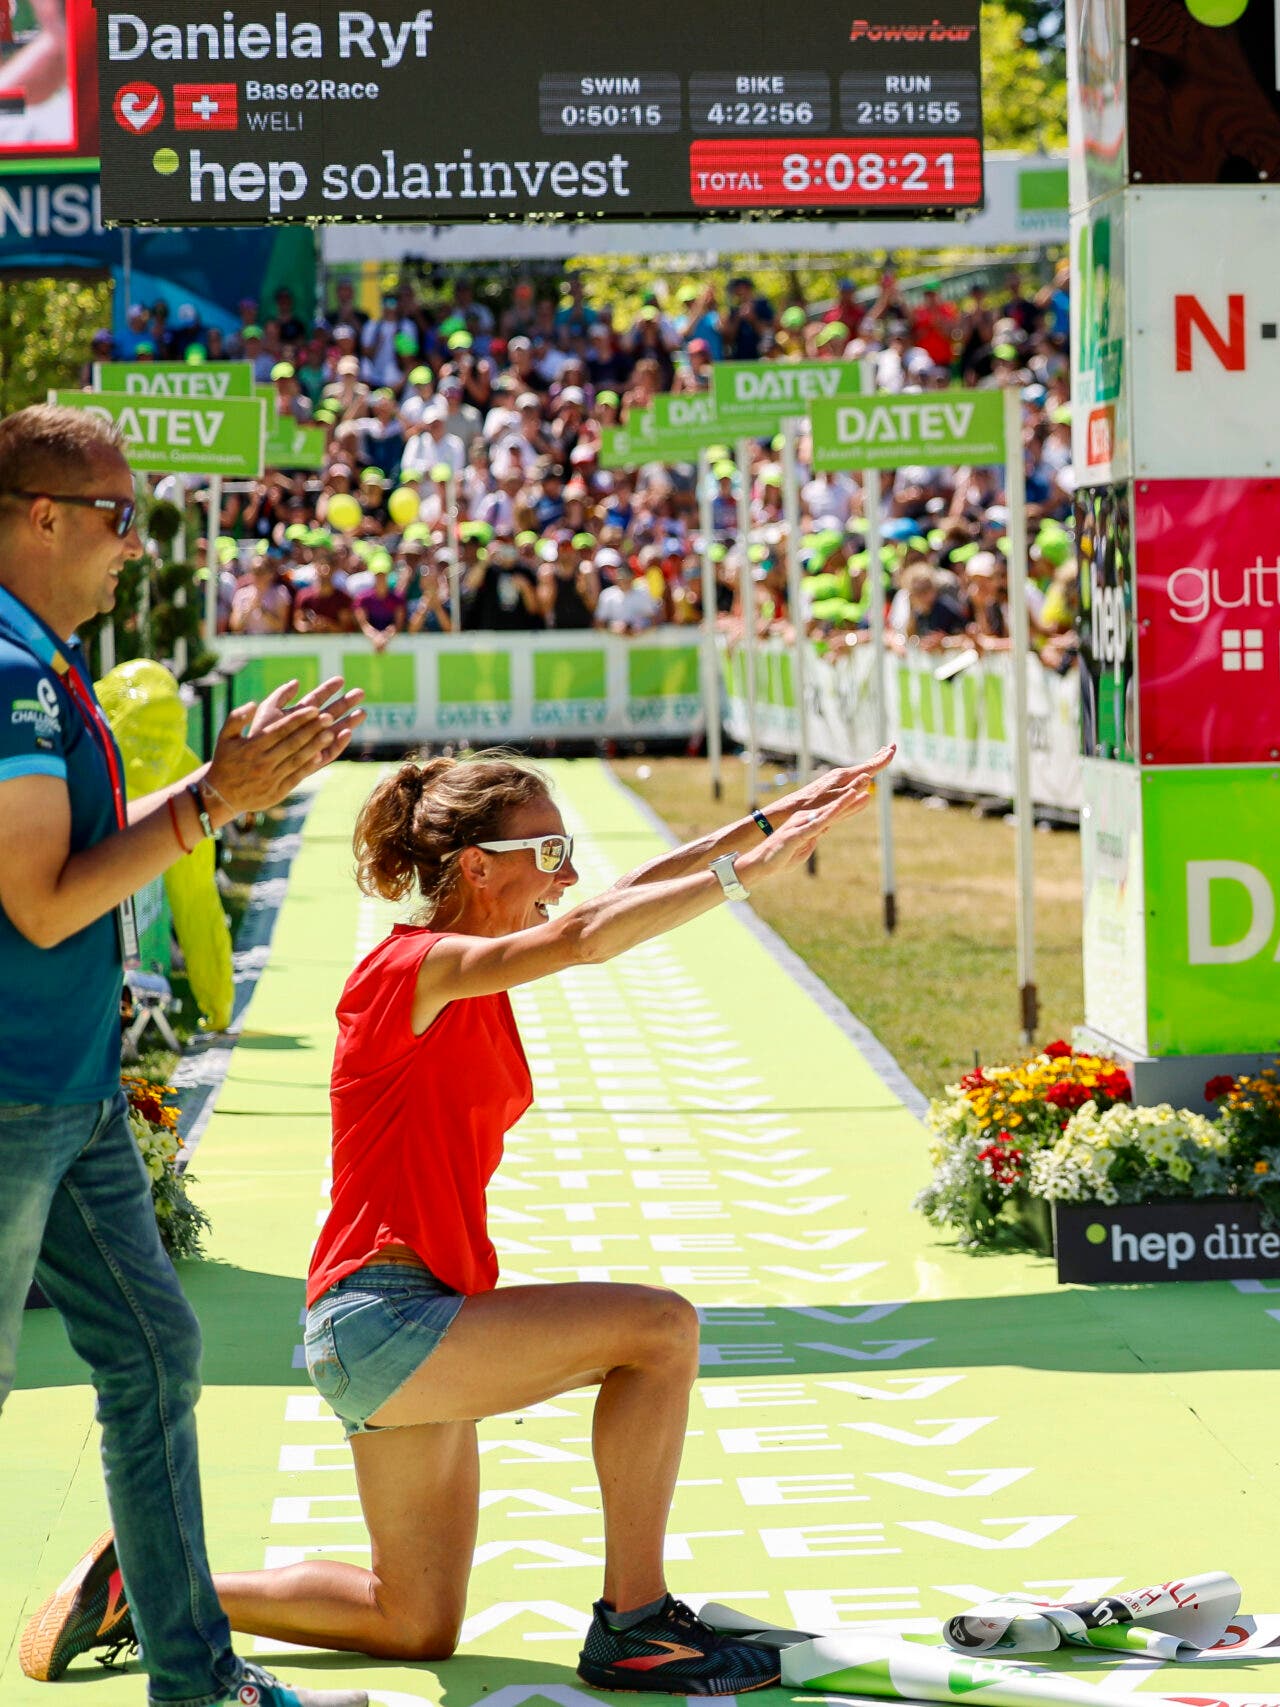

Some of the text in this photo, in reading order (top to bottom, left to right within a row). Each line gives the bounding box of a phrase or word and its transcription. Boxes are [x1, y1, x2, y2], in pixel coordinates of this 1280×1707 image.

[108, 9, 433, 68] Daniela Ryf
[850, 19, 977, 43] Powerbar
[246, 80, 379, 100] Base2Race
[580, 77, 640, 95] SWIM
[736, 75, 784, 94] BIKE
[886, 75, 931, 92] RUN
[561, 104, 662, 126] 0:50:15
[707, 102, 813, 125] 4:22:56
[857, 101, 961, 124] 2:51:55
[190, 149, 630, 212] hep solarinvest
[697, 153, 956, 192] TOTAL 8:08:21
[125, 372, 231, 397] DATEV
[735, 369, 842, 398] DATEV
[836, 403, 974, 443] DATEV
[1112, 1222, 1196, 1269] hep
